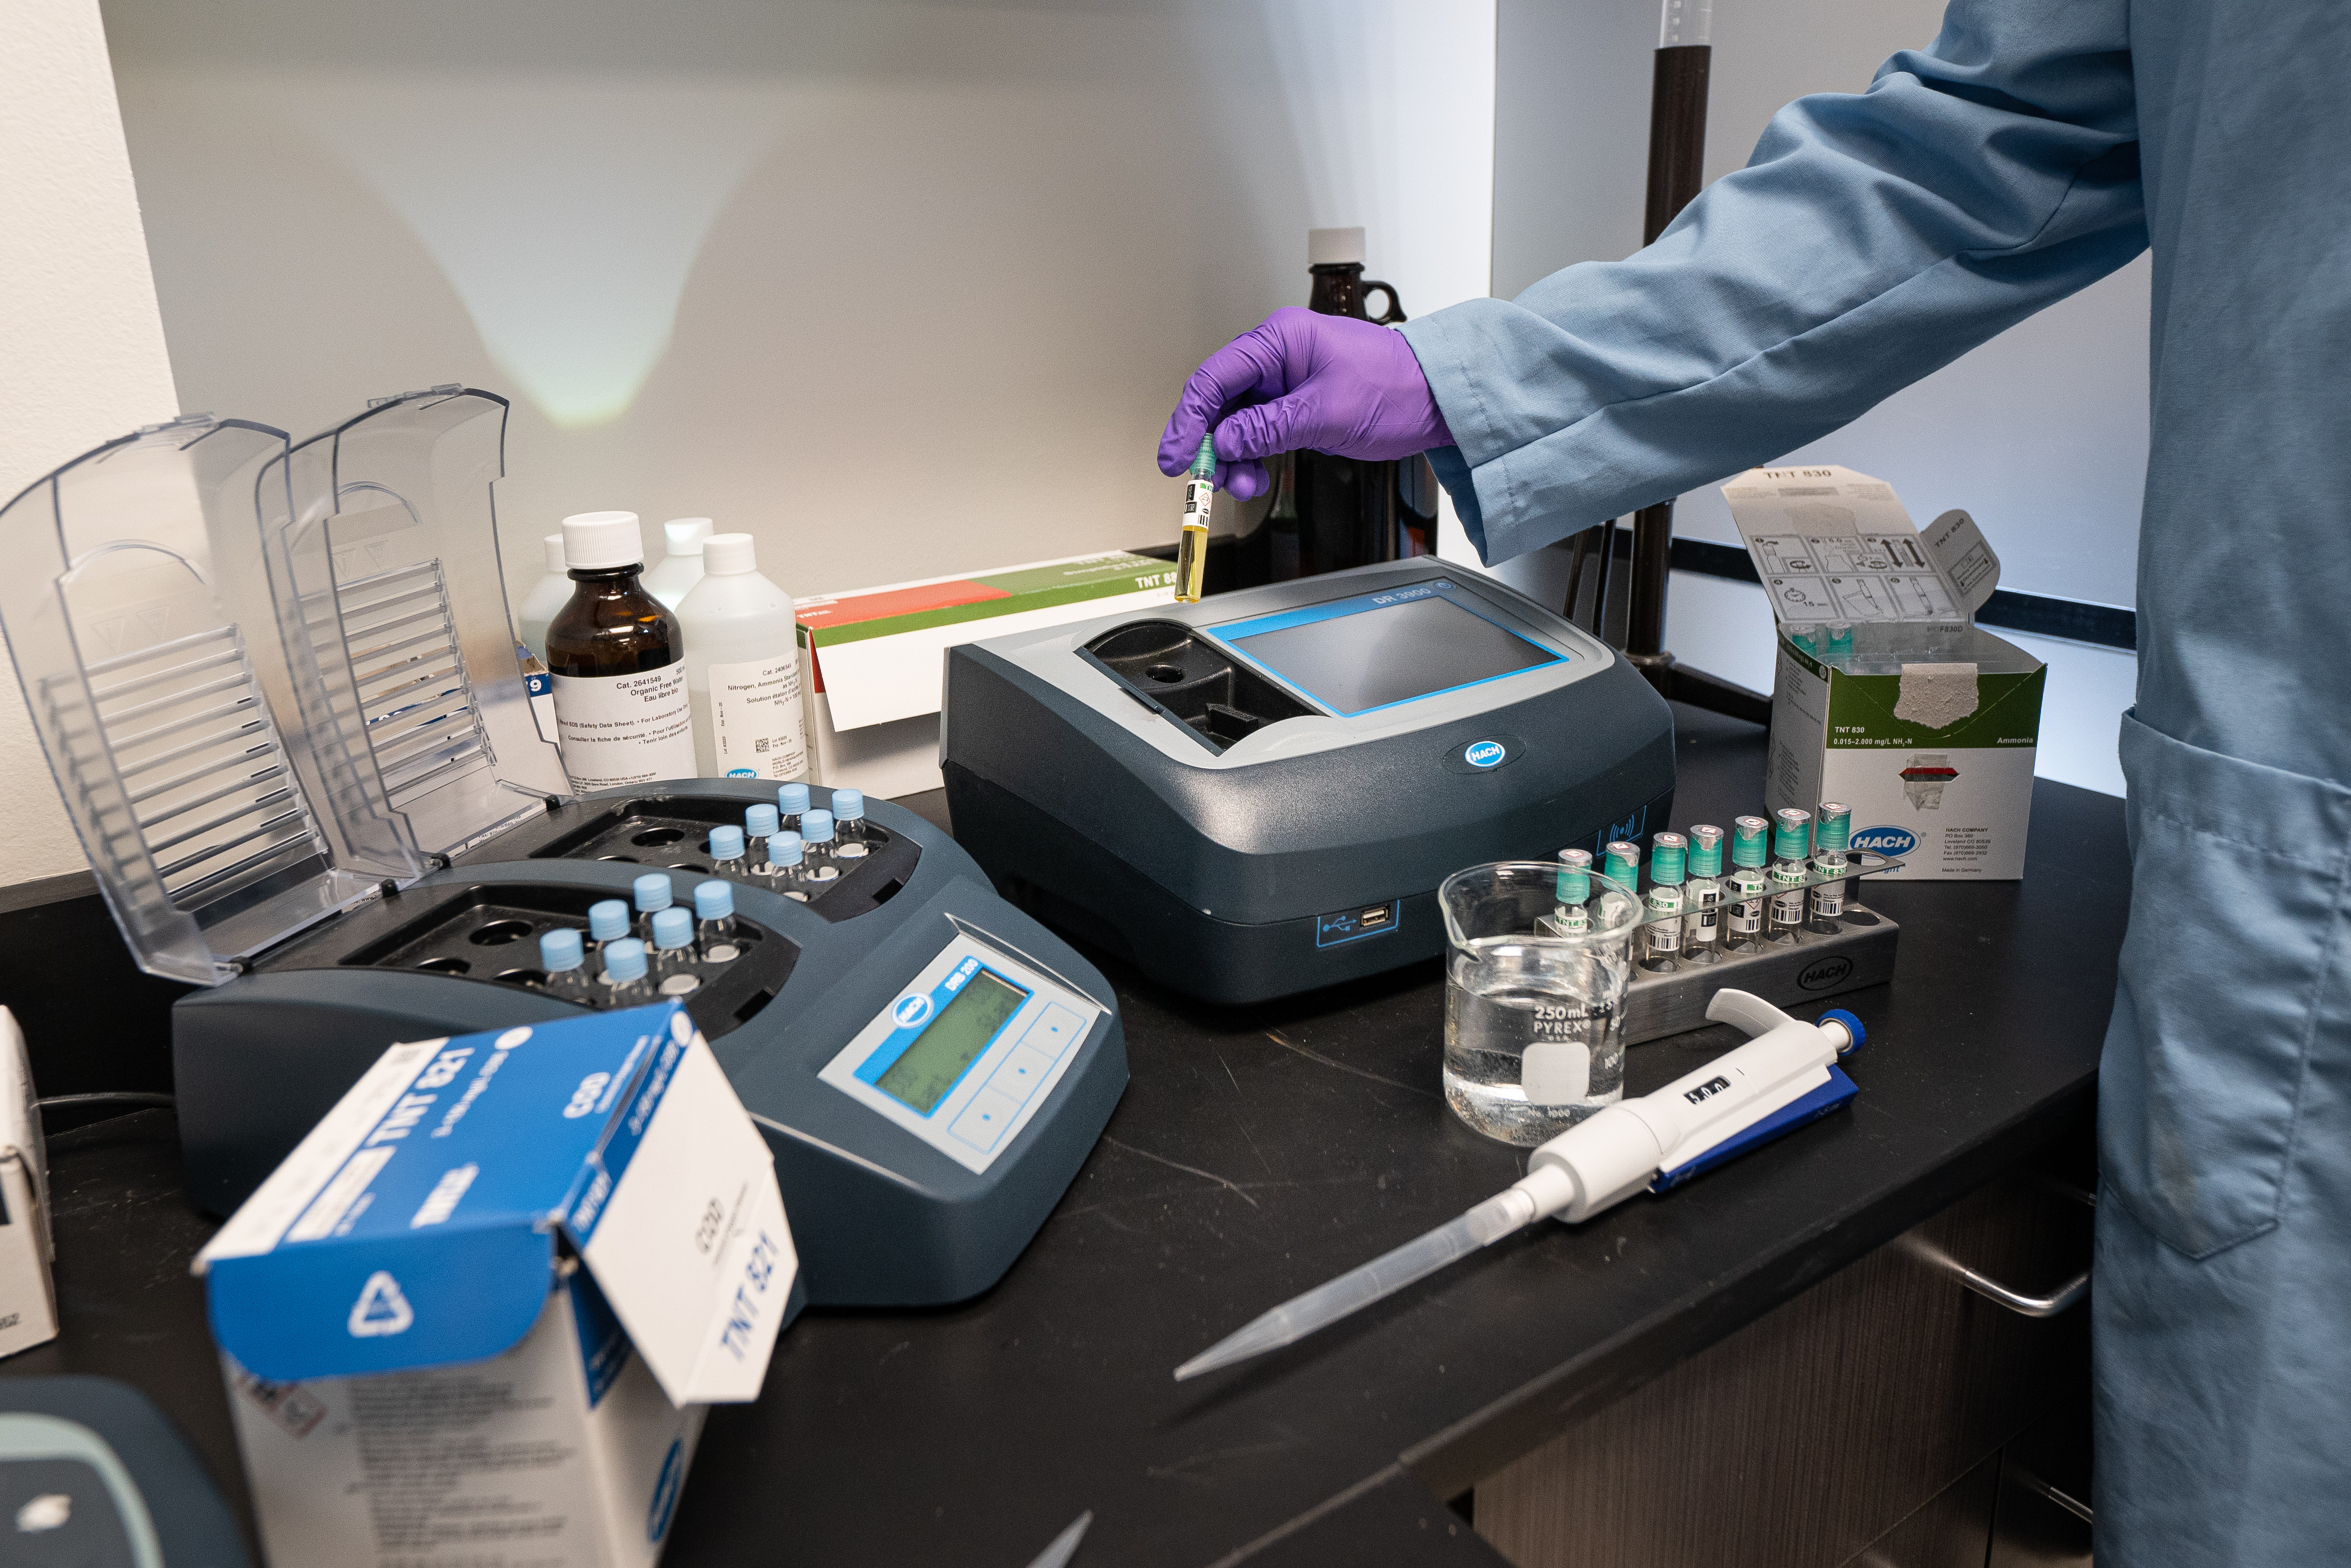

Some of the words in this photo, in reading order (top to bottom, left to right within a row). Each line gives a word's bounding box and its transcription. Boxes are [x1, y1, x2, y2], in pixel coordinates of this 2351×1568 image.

[1764, 471, 1798, 479] TNT
[1803, 469, 1832, 478] 830
[1935, 531, 1950, 547] TNT
[1951, 517, 1964, 533] 830
[1135, 574, 1160, 589] TNT
[1372, 595, 1397, 604] DR
[631, 686, 658, 696] Organic
[672, 676, 683, 685] Water
[634, 676, 661, 687] 2641549
[758, 678, 783, 687] Ammonia
[746, 695, 771, 703] Solution
[652, 710, 676, 721] Laboratory
[1472, 745, 1500, 761] HACH
[730, 770, 754, 778] HACH
[1854, 836, 1912, 848] HACH
[1814, 864, 1831, 874] TNT
[1777, 874, 1796, 882] TNT
[1652, 899, 1668, 908] 830
[1558, 917, 1575, 926] TNT
[945, 972, 966, 991] DRB
[960, 958, 978, 975] 200
[1803, 963, 1848, 984] HACH
[898, 997, 925, 1023] HACH
[719, 1282, 762, 1363] TNT
[745, 1230, 780, 1293] 821
